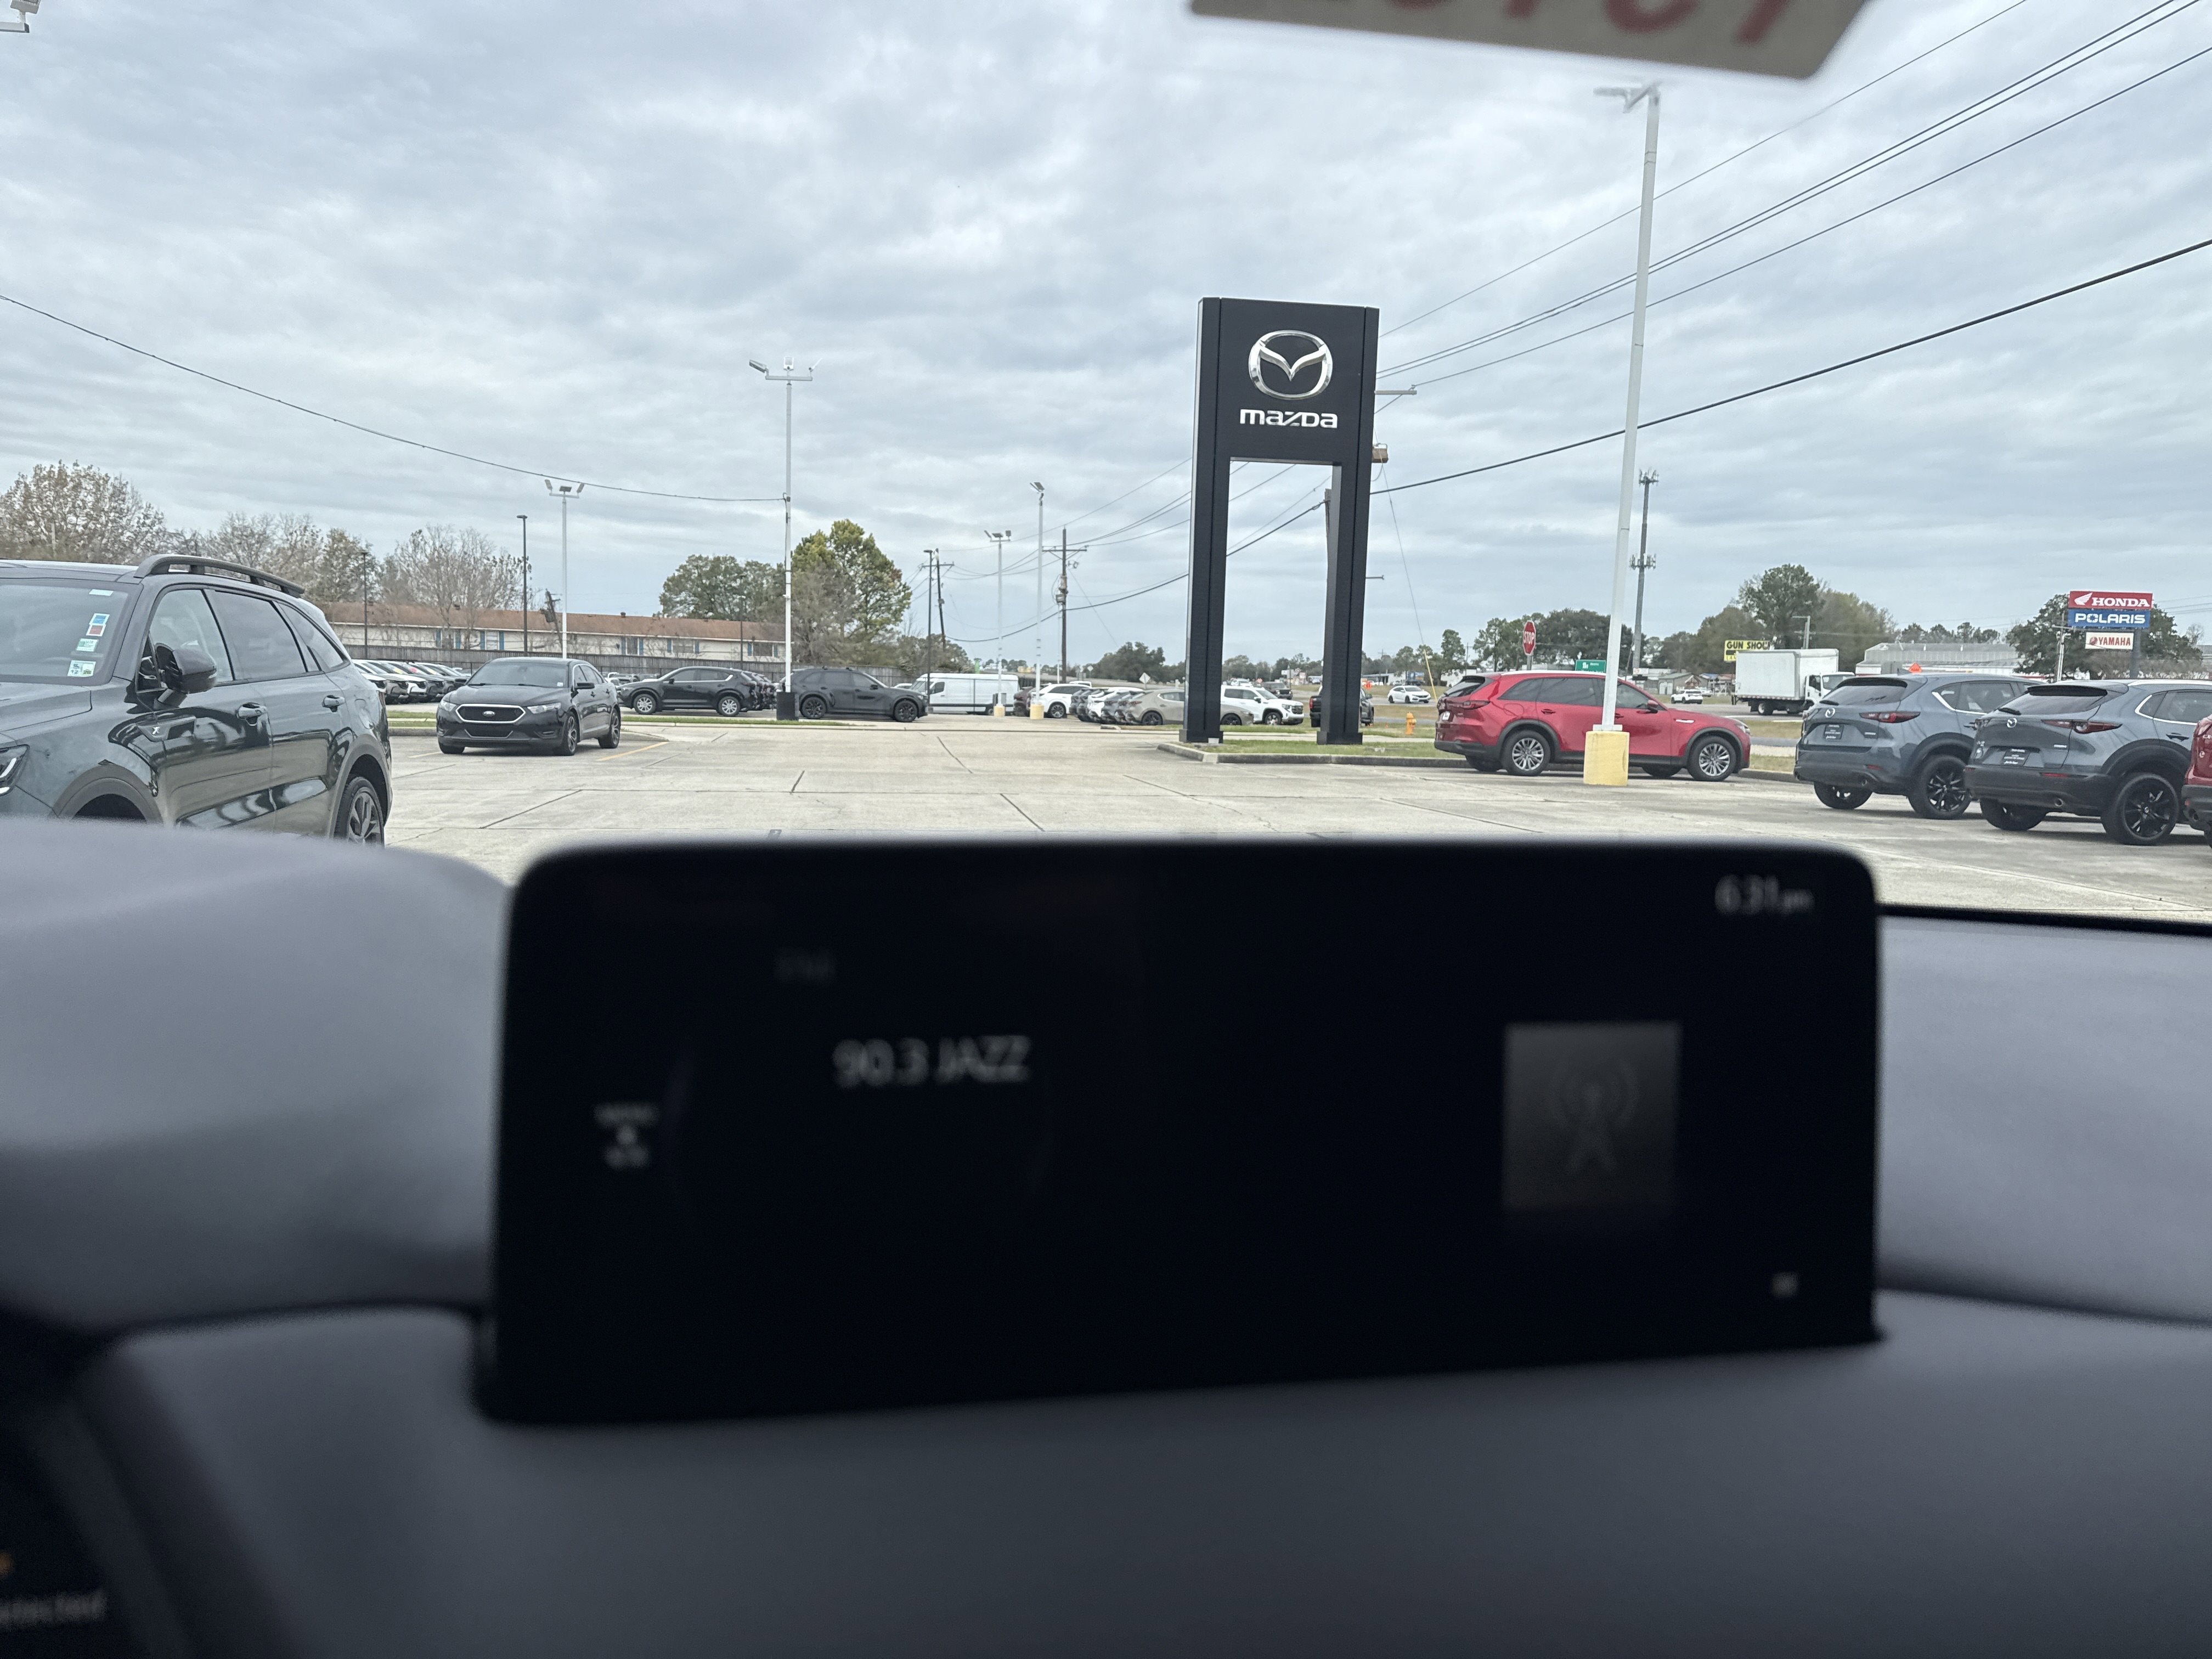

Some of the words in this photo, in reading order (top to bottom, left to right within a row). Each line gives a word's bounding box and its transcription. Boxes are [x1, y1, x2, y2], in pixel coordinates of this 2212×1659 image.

[2091, 597, 2150, 607] HONDA
[2075, 613, 2146, 624] POLARIS
[1523, 631, 1535, 645] STOP
[2098, 636, 2131, 646] YAMAHA
[1726, 641, 1743, 650] GUN
[934, 1035, 1031, 1086] JAZZ
